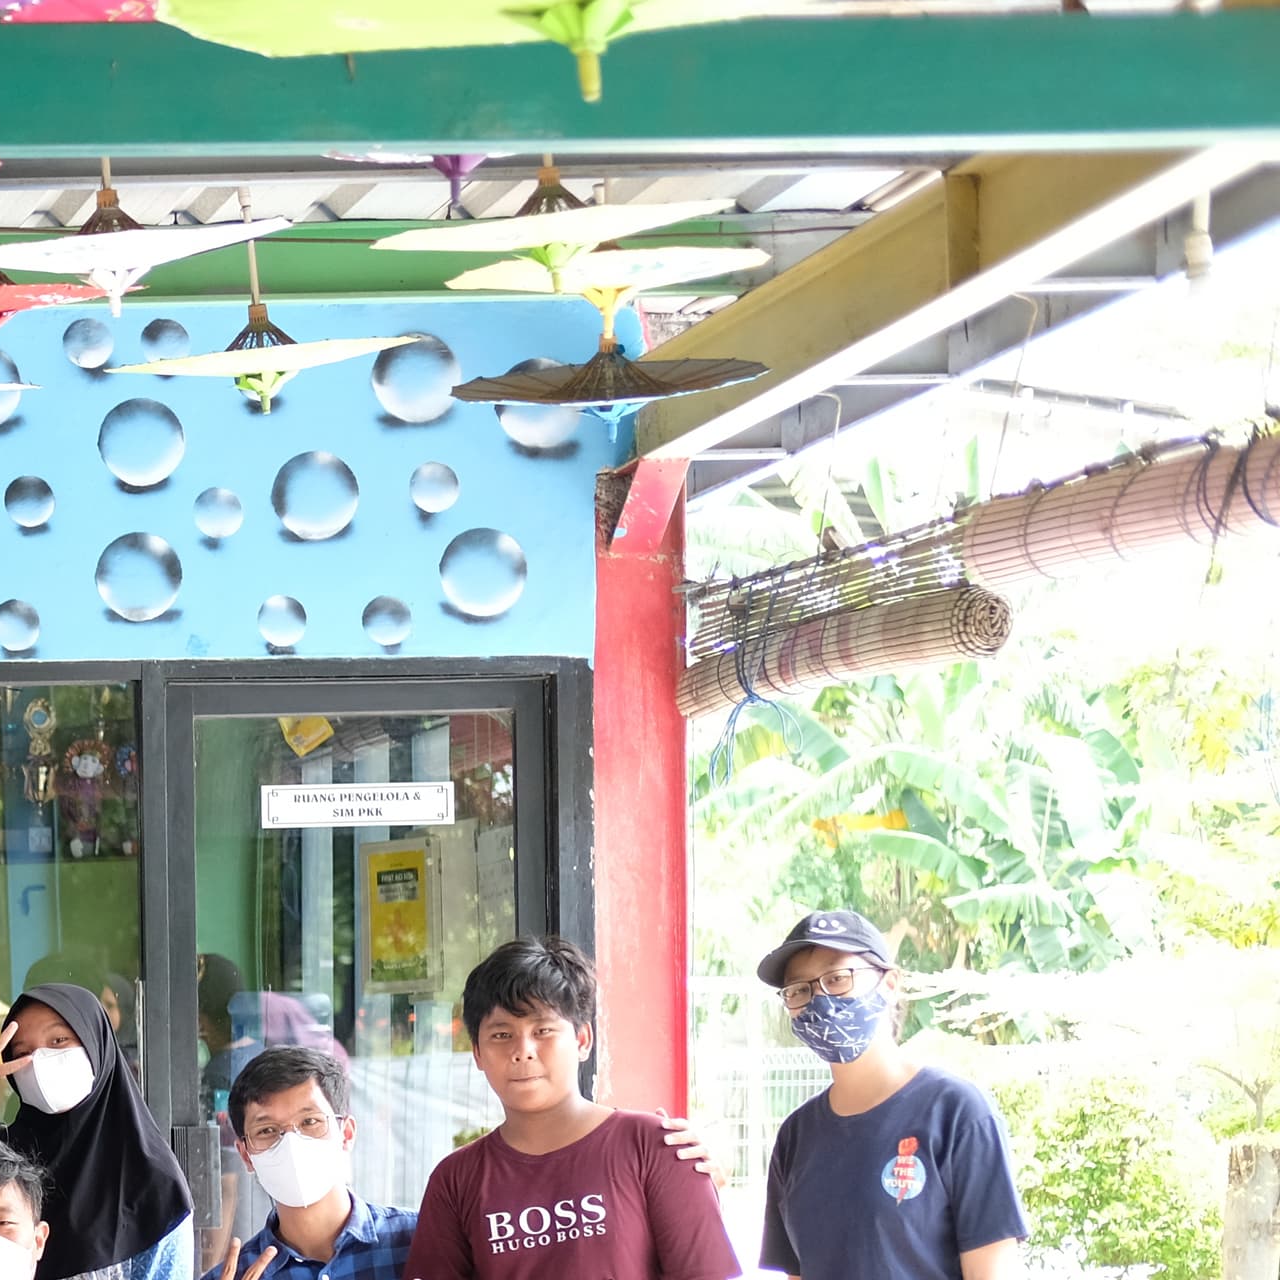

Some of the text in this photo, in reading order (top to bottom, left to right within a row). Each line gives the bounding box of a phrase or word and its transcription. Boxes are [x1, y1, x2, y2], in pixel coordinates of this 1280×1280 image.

[412, 790, 422, 801] &
[332, 806, 383, 818] SIM PKK
[485, 1194, 608, 1242] BOSS
[491, 1223, 607, 1254] HUGO BOSS
